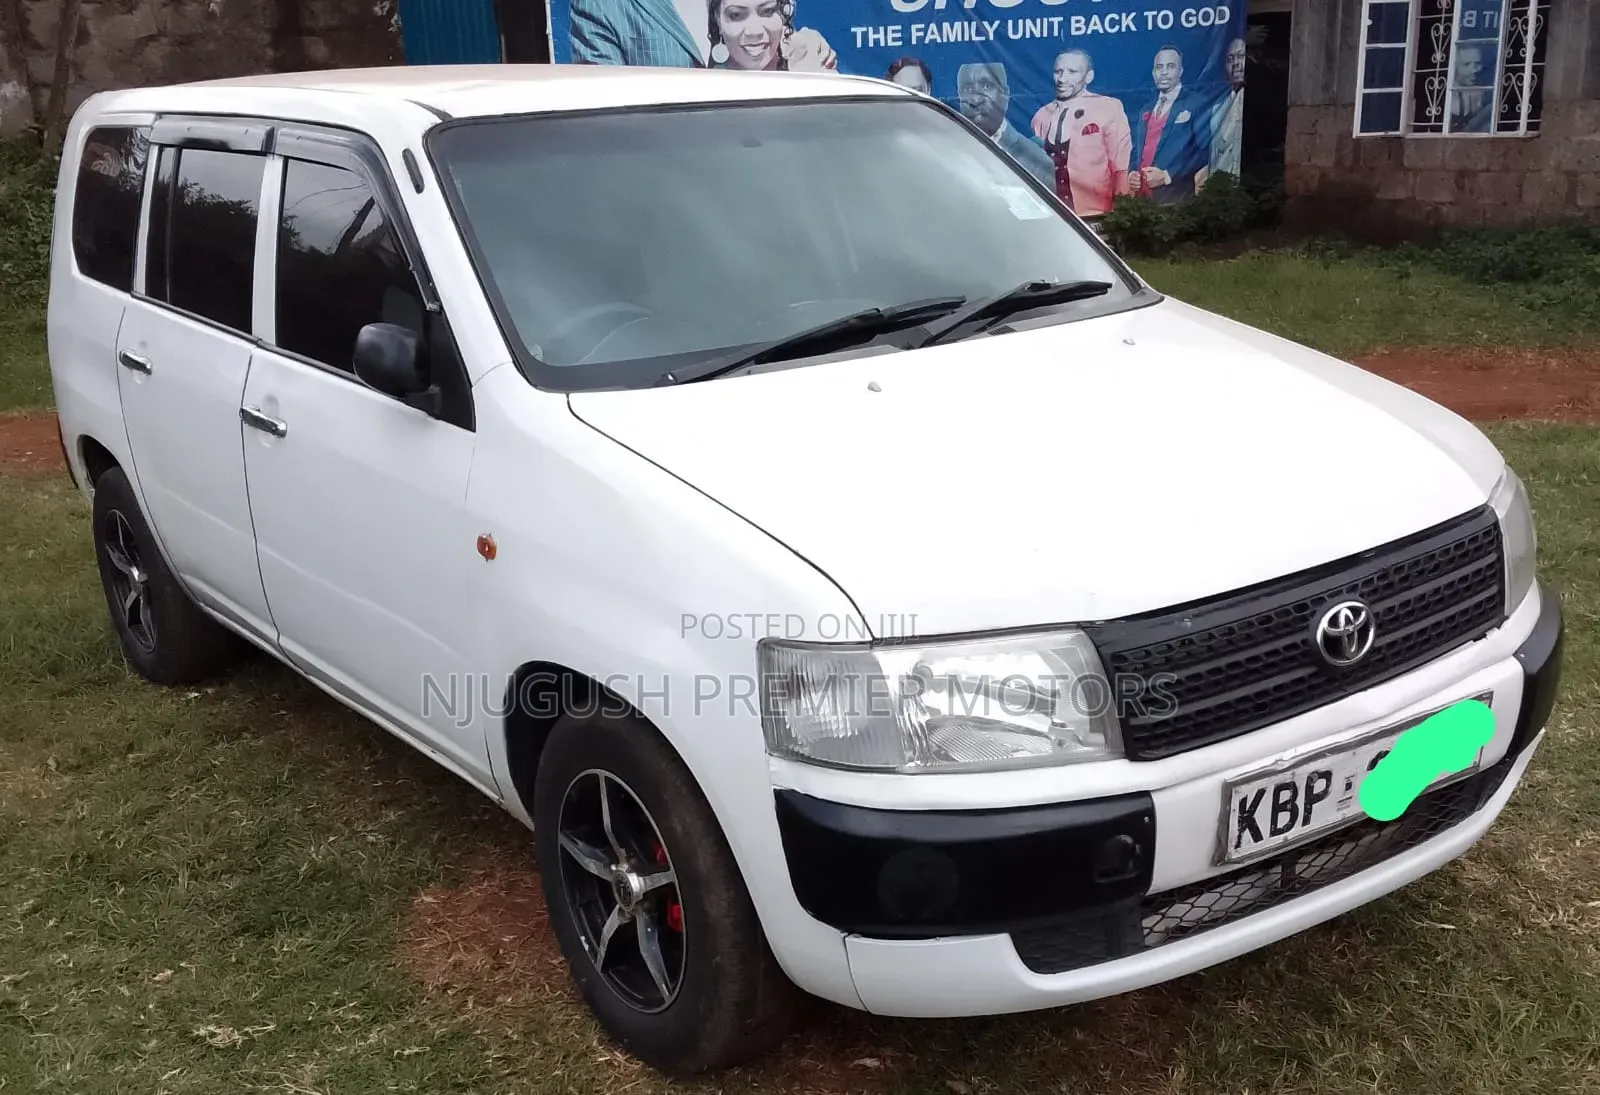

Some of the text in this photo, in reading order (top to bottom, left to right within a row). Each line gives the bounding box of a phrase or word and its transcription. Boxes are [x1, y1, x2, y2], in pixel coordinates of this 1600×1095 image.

[851, 5, 1231, 49] THE FAMILY UNIT BACK TO GOD
[1234, 769, 1332, 849] KBP
